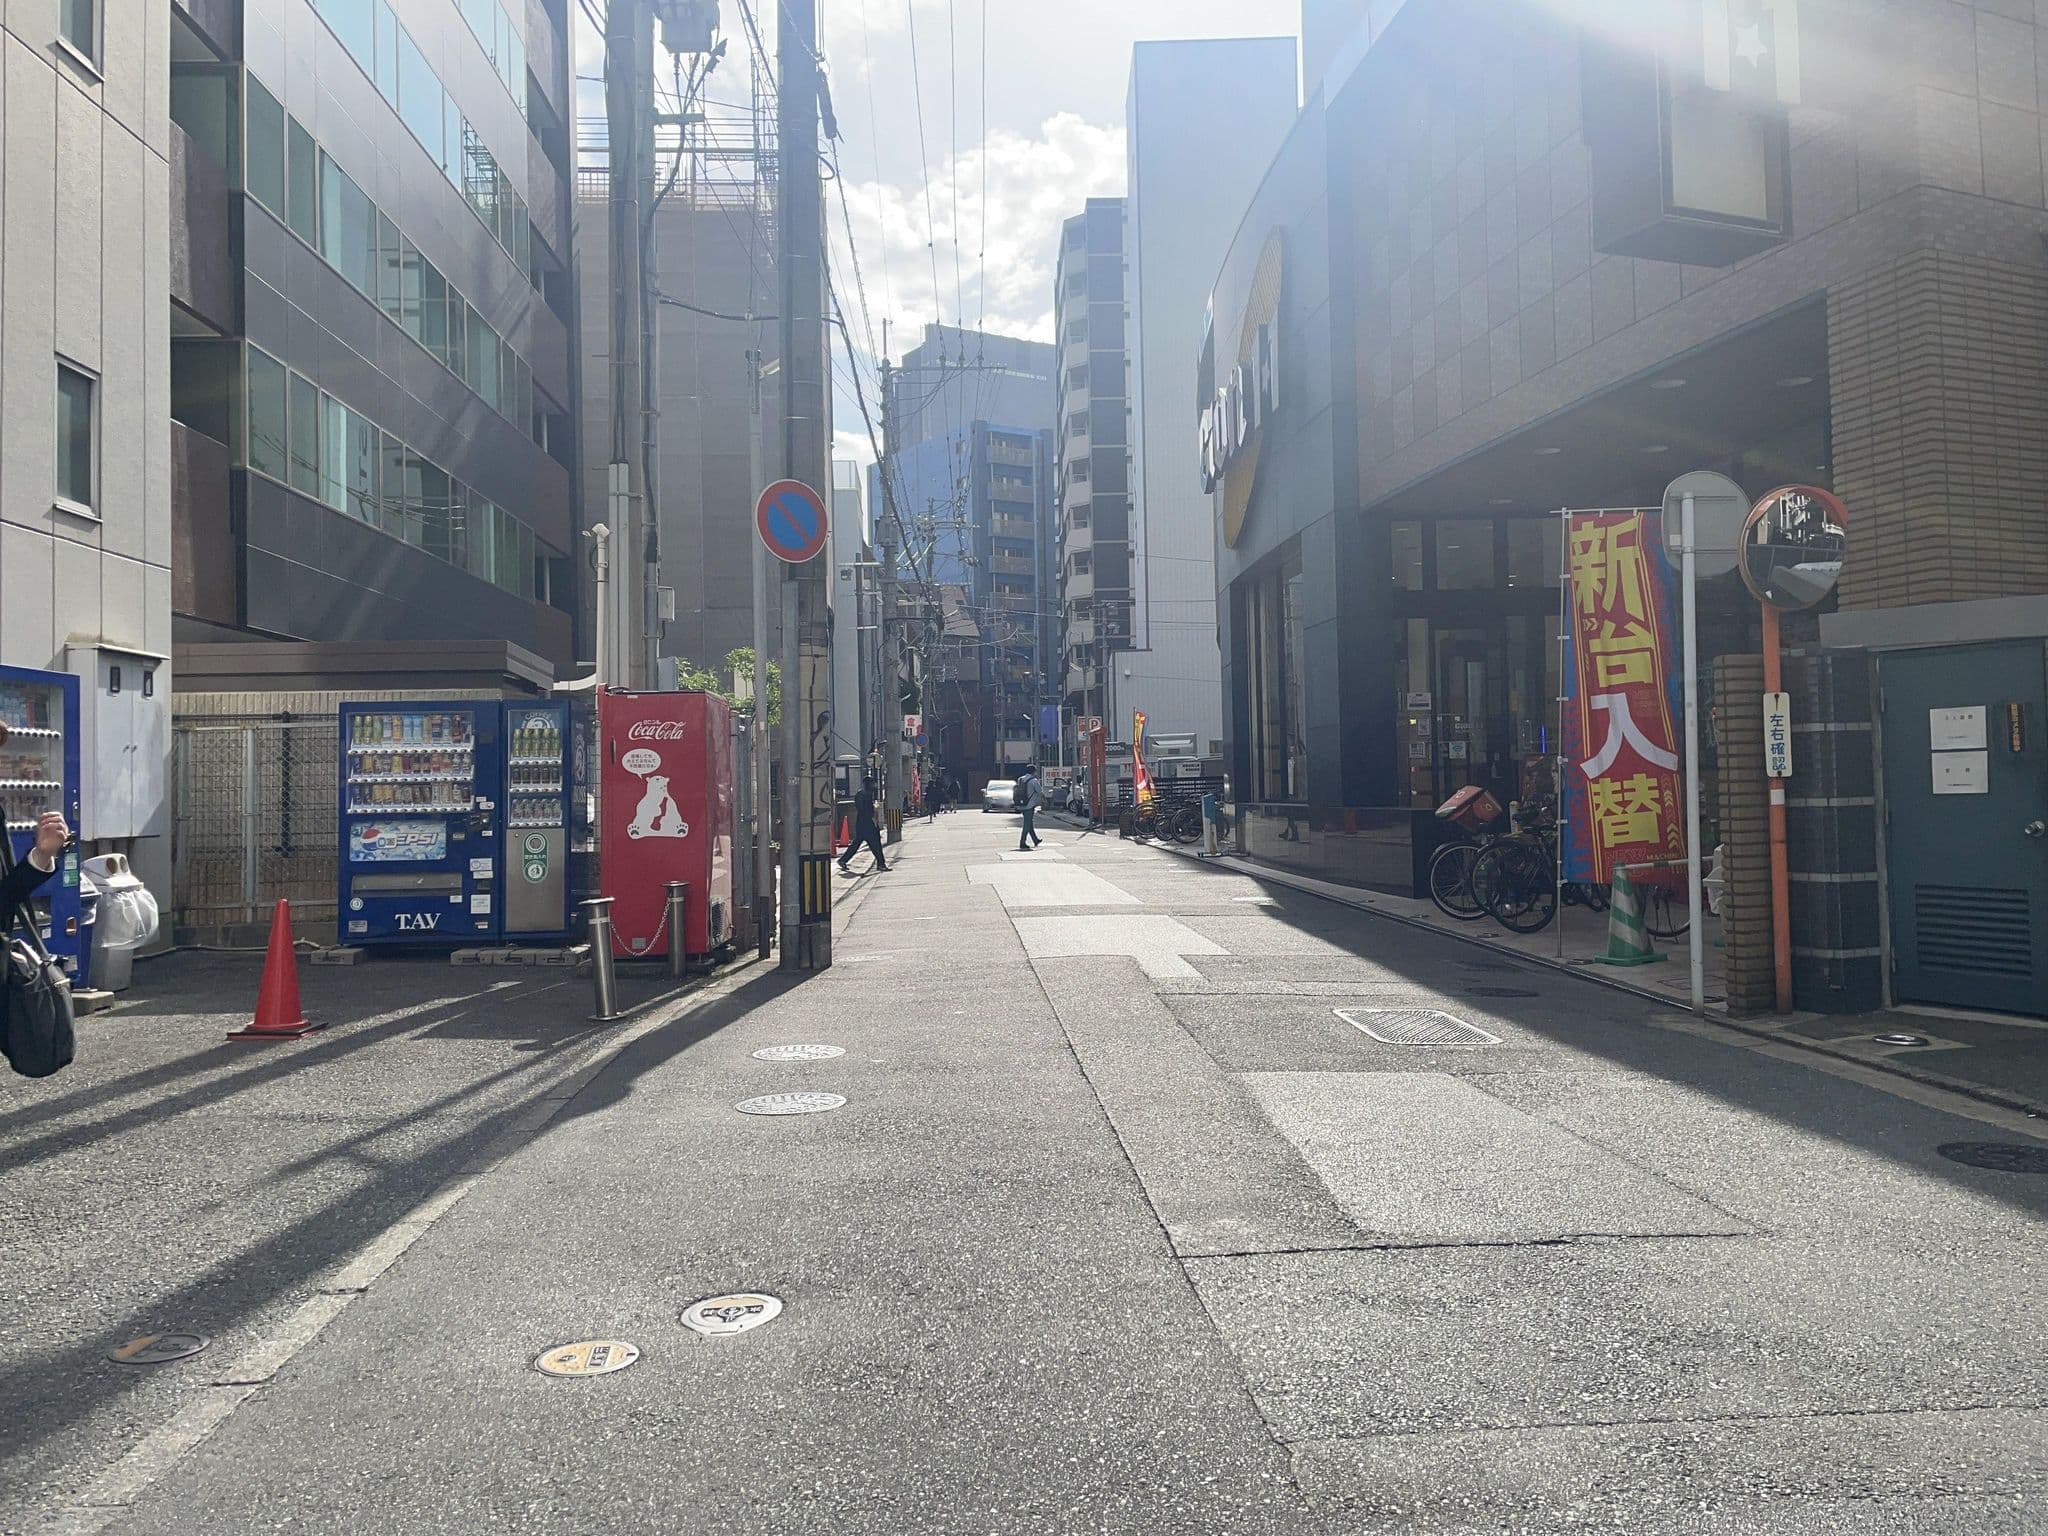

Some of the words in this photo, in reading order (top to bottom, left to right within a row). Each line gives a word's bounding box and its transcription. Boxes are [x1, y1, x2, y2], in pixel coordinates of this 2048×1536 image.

[1570, 516, 1679, 848] 新台入替
[628, 720, 686, 741] Coca-Cola
[1769, 714, 1786, 771] 左右確認
[393, 833, 439, 846] EPSI
